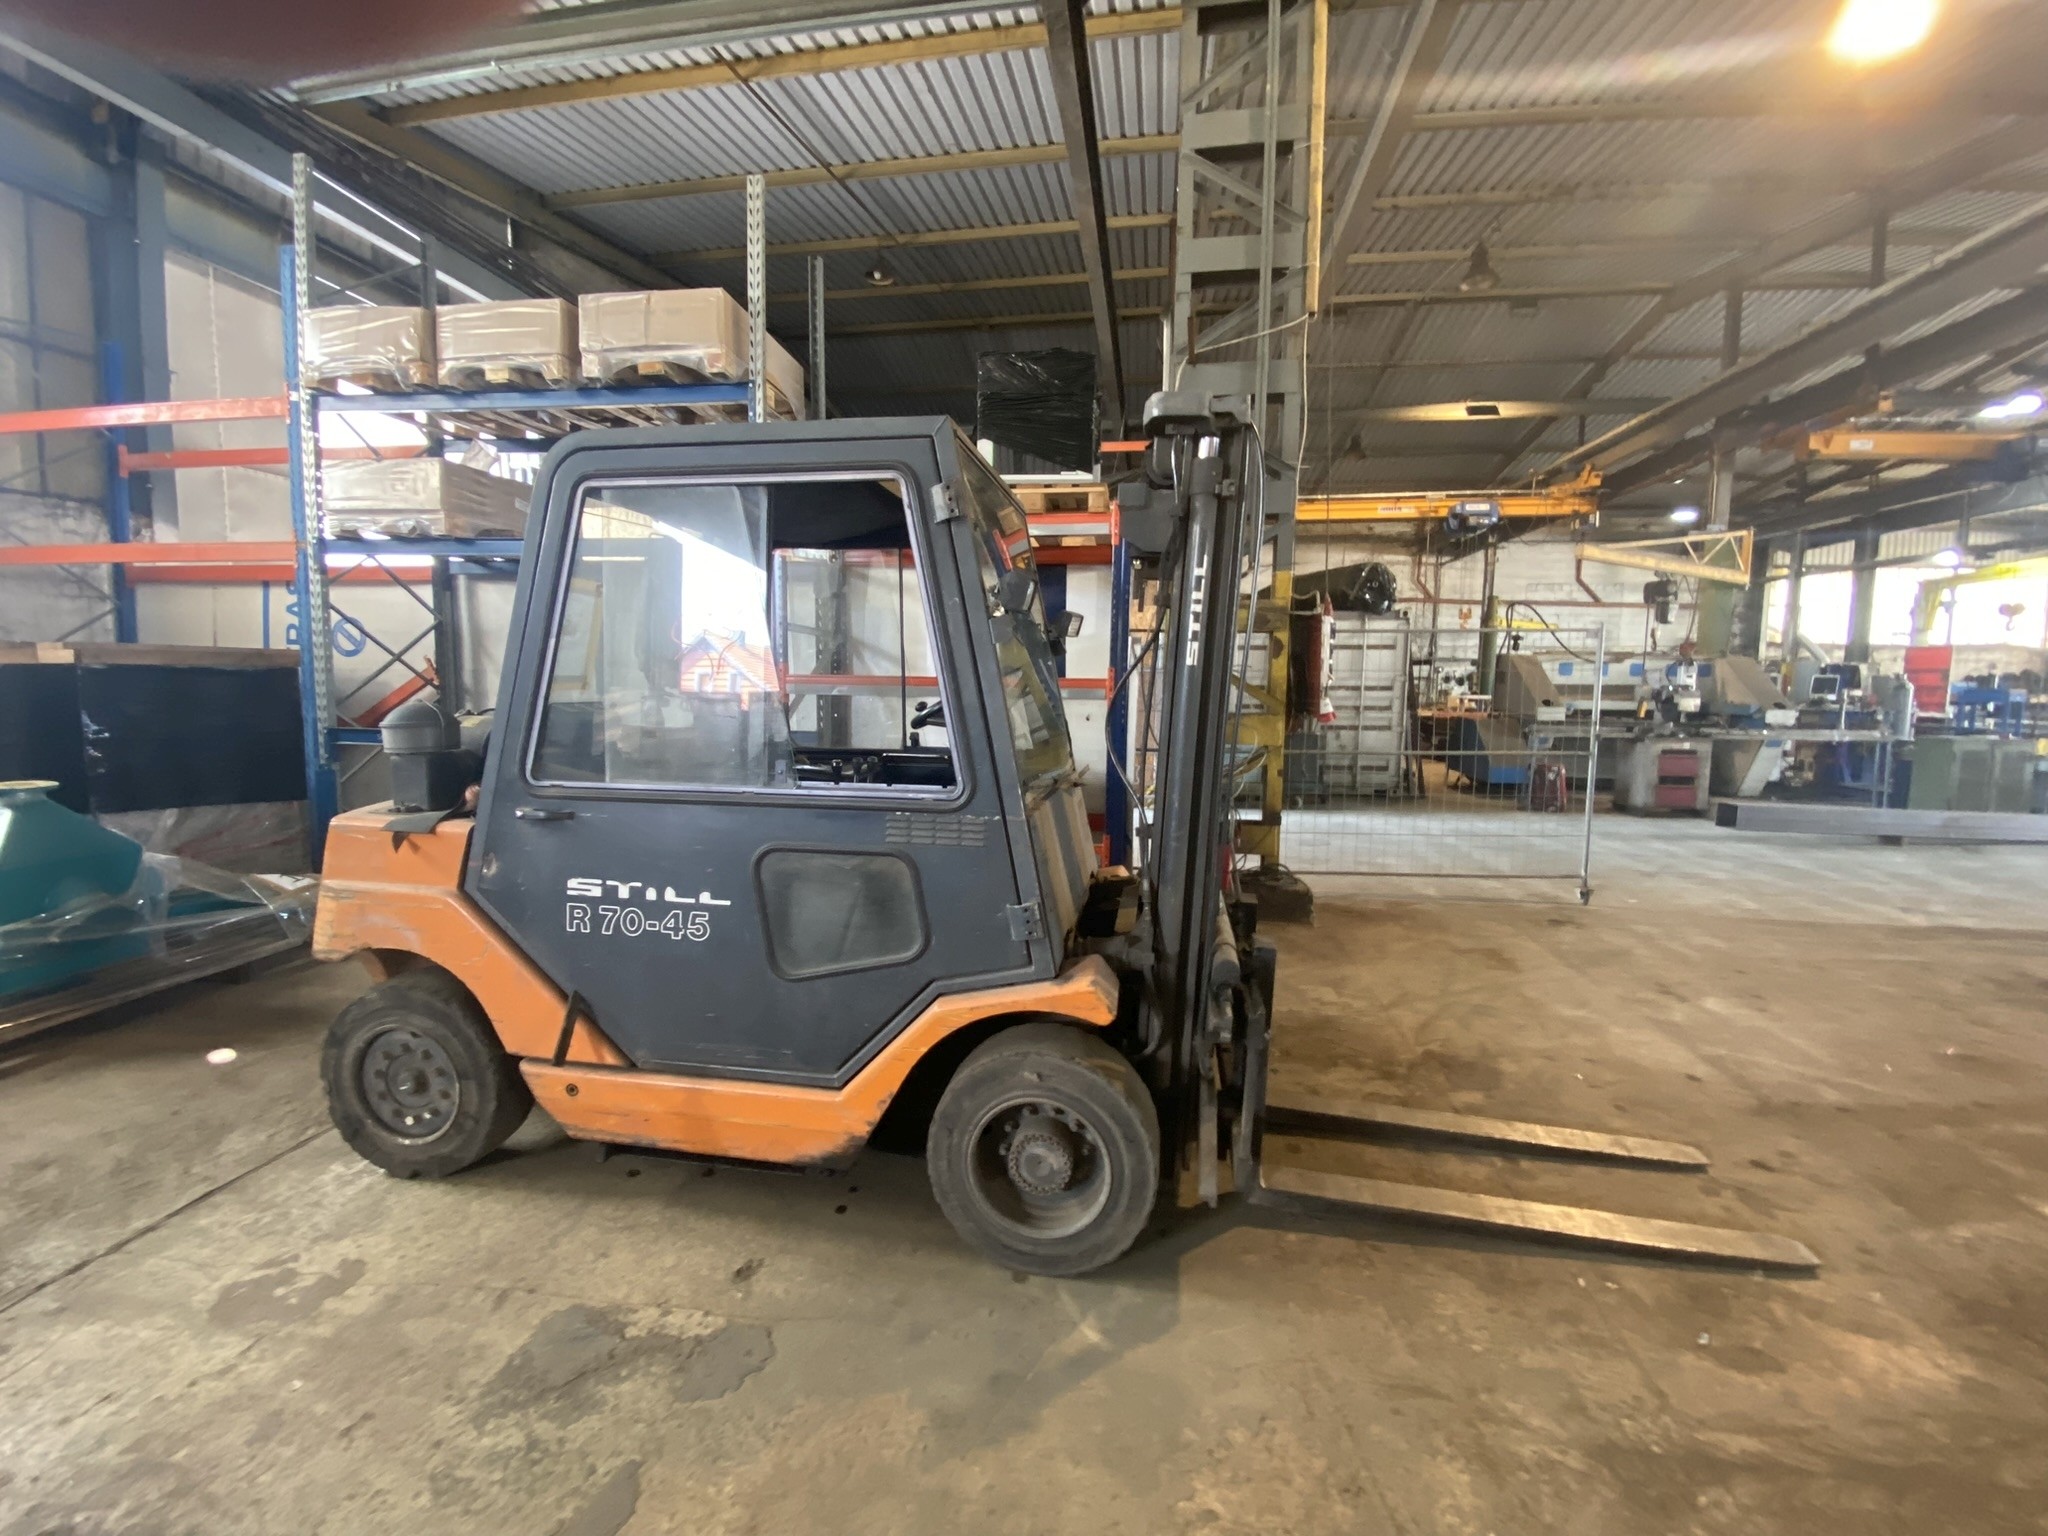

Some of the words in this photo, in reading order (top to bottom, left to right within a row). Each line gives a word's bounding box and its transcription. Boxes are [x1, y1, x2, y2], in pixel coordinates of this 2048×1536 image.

[1187, 554, 1208, 666] STILL
[566, 878, 732, 906] STILL
[566, 903, 591, 933] R
[598, 905, 711, 942] 70-45
